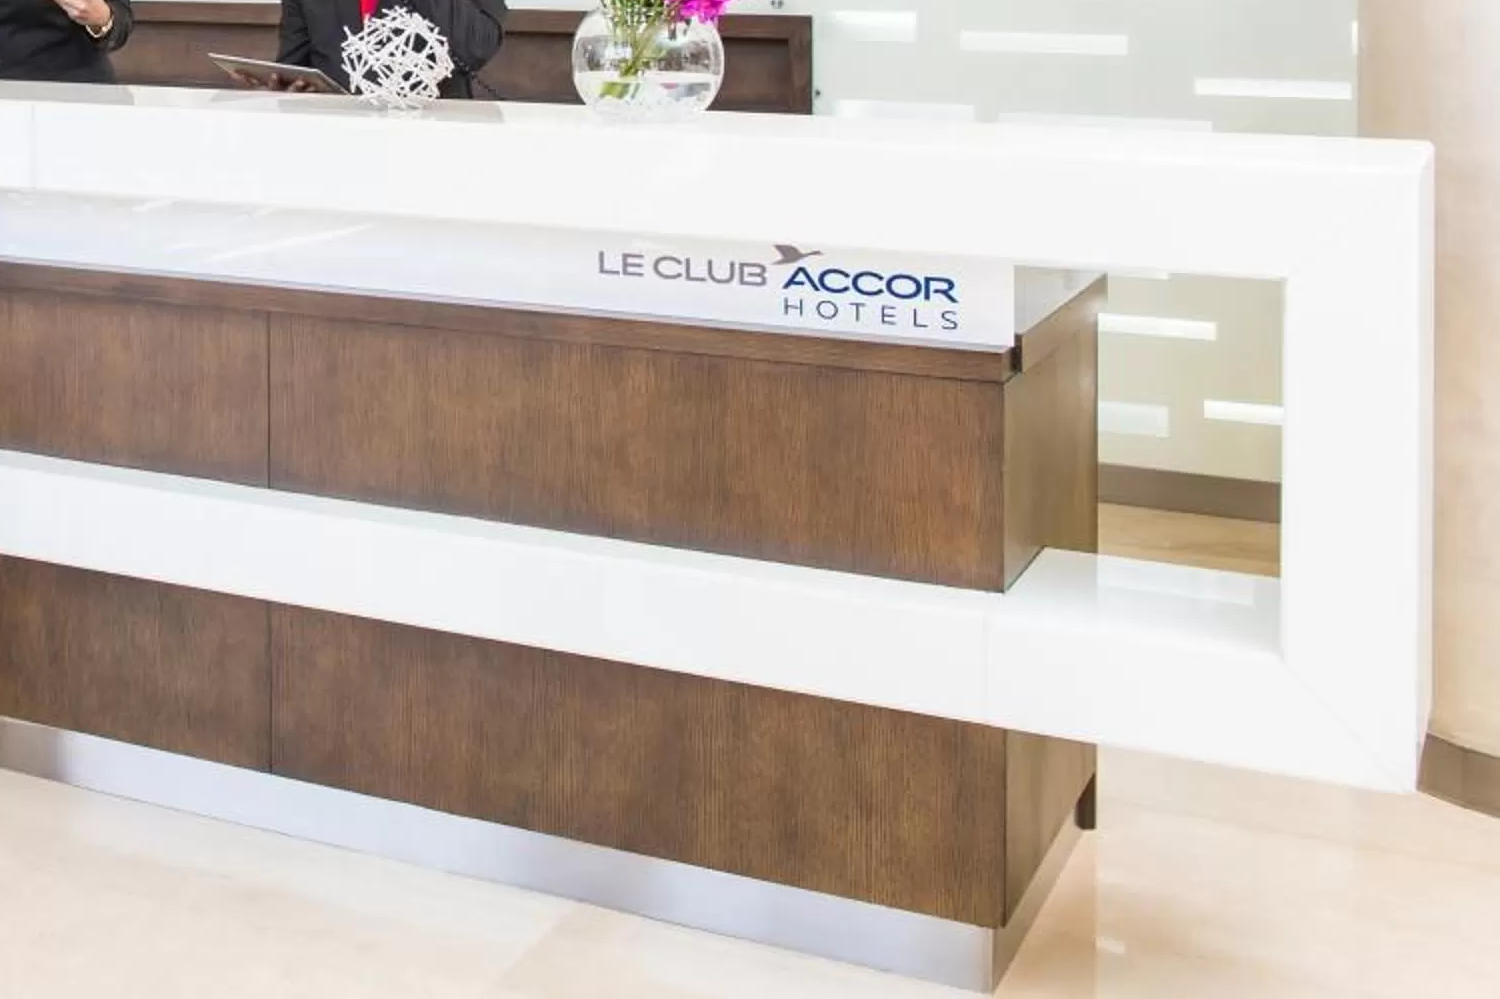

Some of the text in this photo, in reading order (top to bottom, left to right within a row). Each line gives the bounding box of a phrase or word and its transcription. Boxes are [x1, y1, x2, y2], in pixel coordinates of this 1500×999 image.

[599, 250, 959, 303] LE CLUB ACCOR
[783, 297, 959, 331] HOTELS
